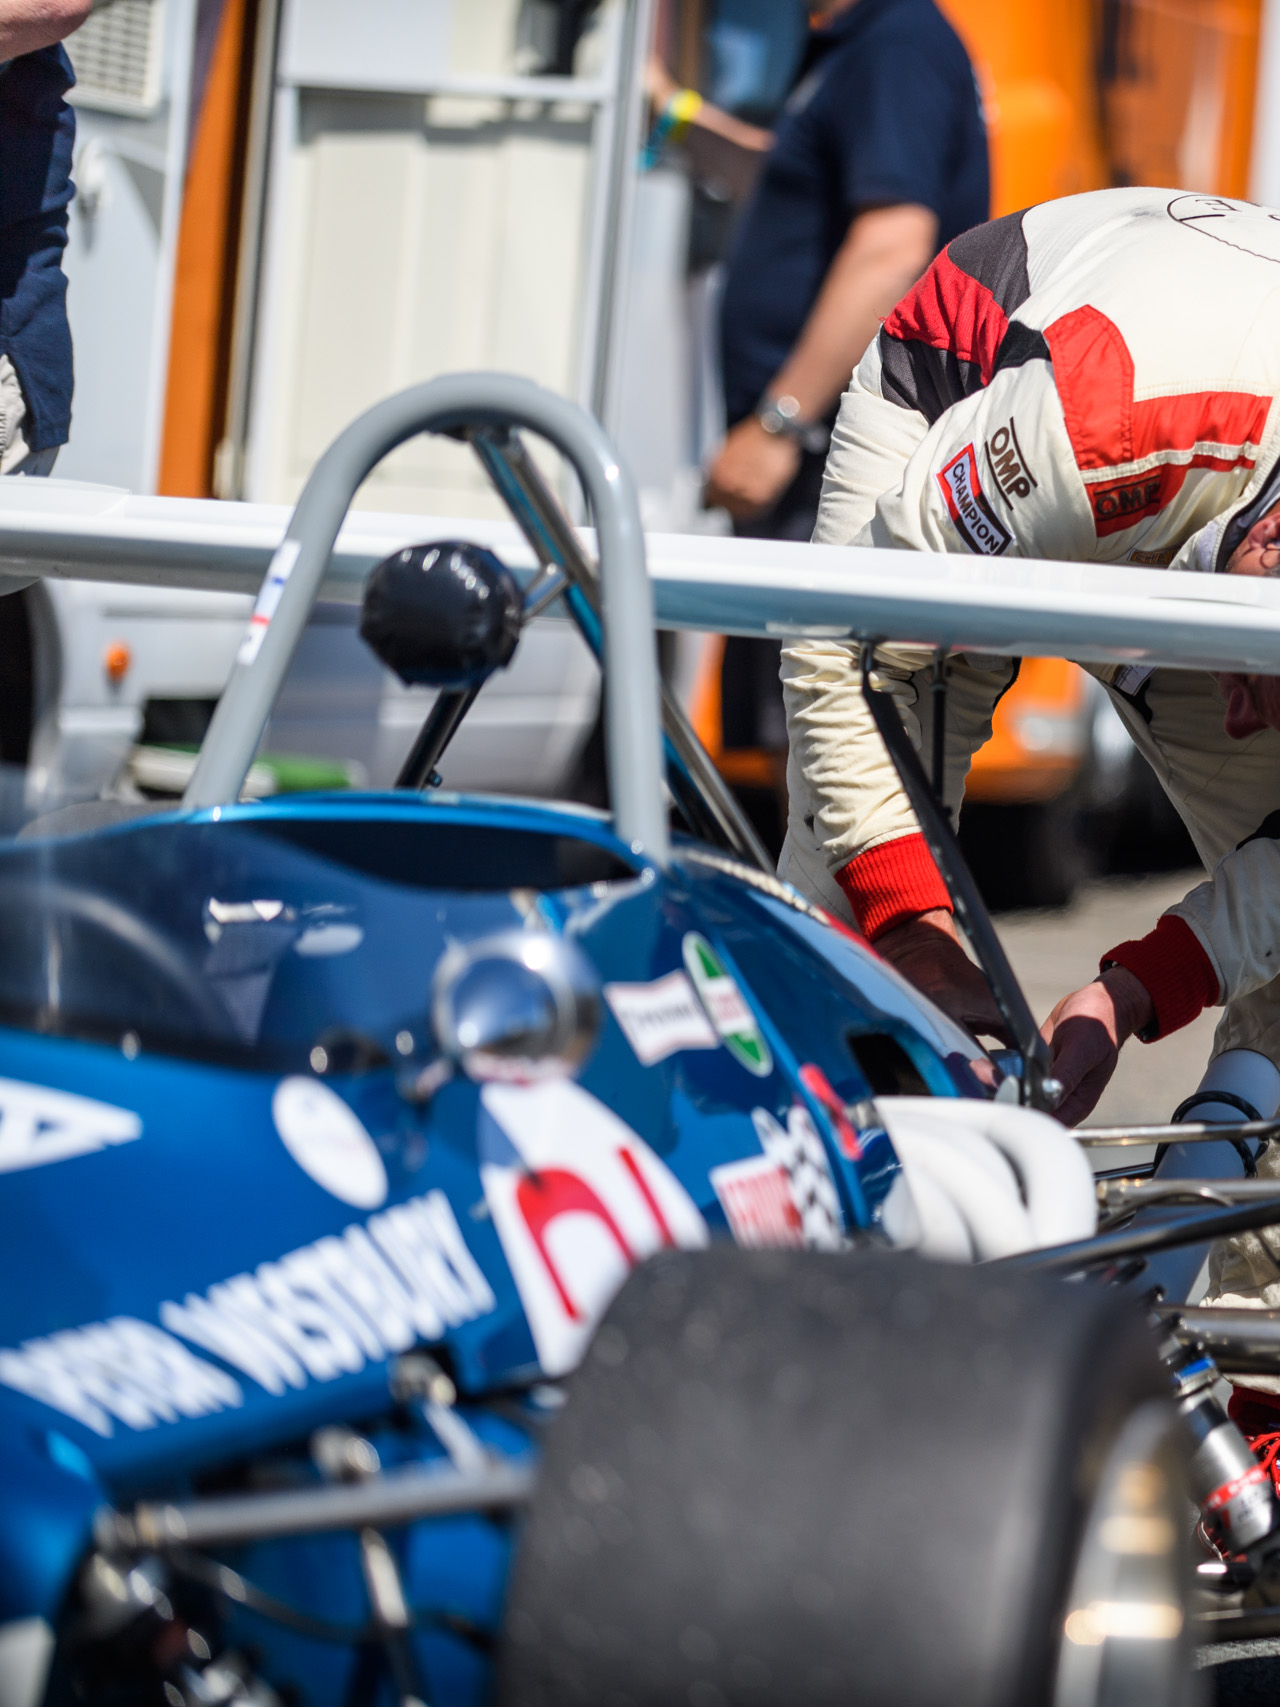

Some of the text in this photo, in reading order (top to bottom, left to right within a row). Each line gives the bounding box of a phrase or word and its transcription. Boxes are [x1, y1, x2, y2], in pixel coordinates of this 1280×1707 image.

[990, 427, 1031, 498] OMP
[1095, 481, 1160, 515] OMP
[953, 462, 1000, 553] CHAMPION
